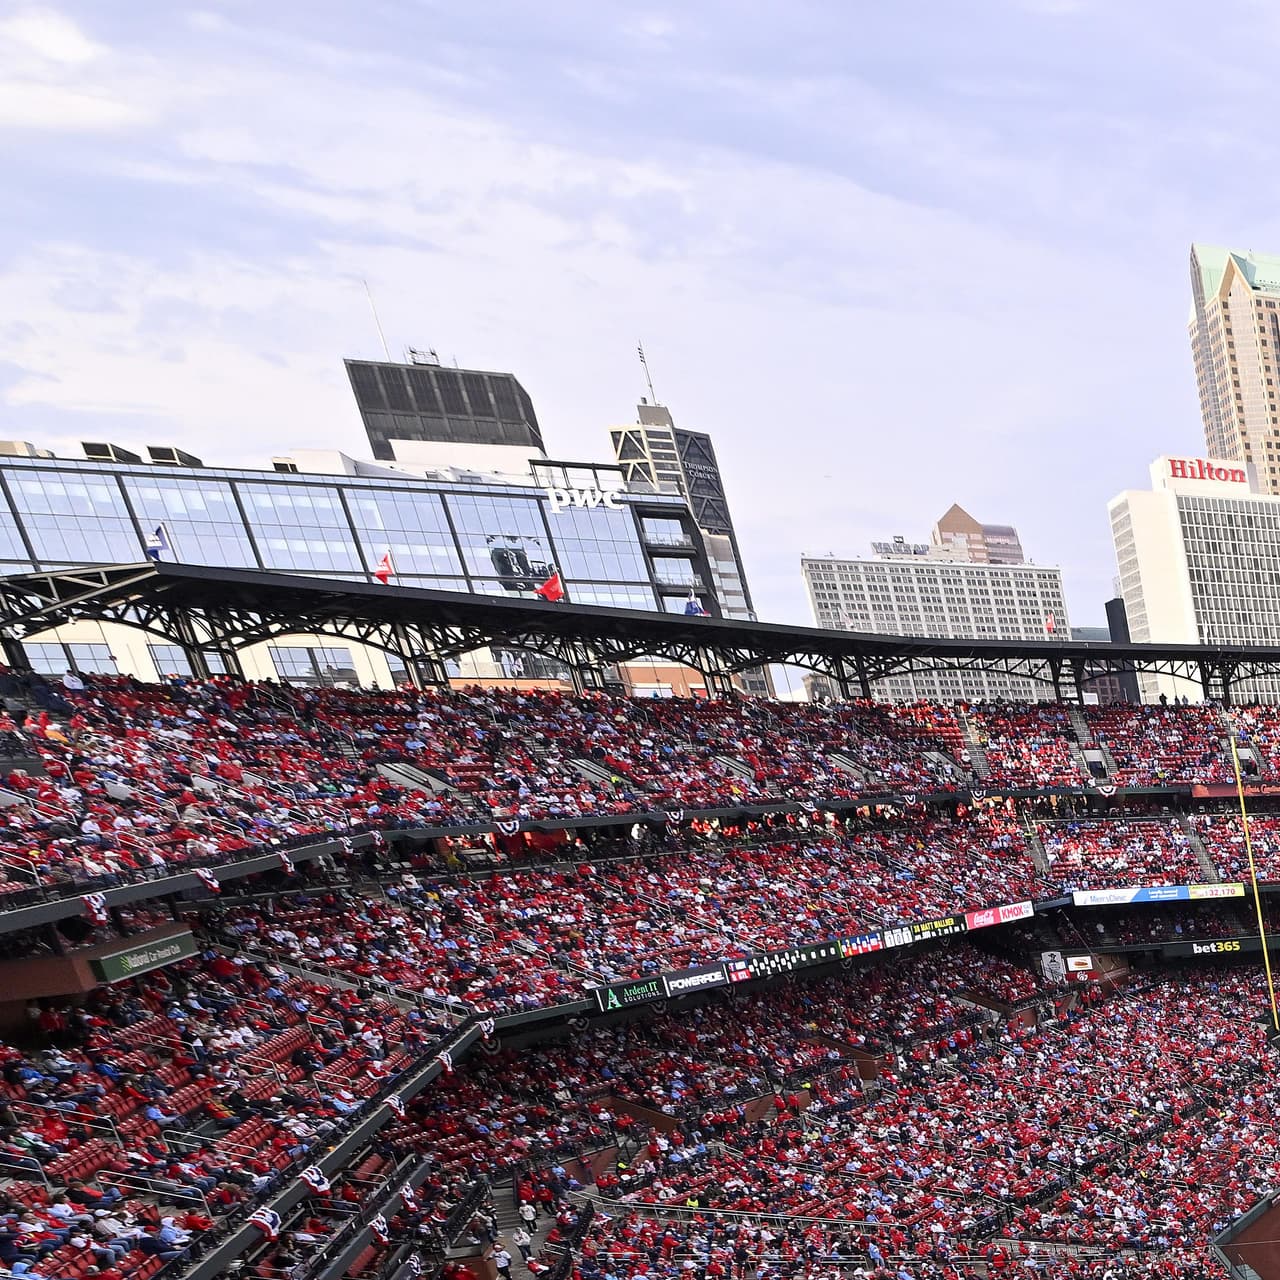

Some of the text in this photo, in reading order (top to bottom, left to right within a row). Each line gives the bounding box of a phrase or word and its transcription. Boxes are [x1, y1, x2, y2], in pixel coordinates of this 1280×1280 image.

[1168, 459, 1247, 483] Hilton
[544, 487, 625, 514] pwc
[1001, 905, 1024, 919] KMOX
[1192, 940, 1241, 955] bet365
[623, 981, 658, 998] Ardent IT
[669, 971, 725, 991] POWERADE
[624, 991, 663, 1002] SOLUTIONS
